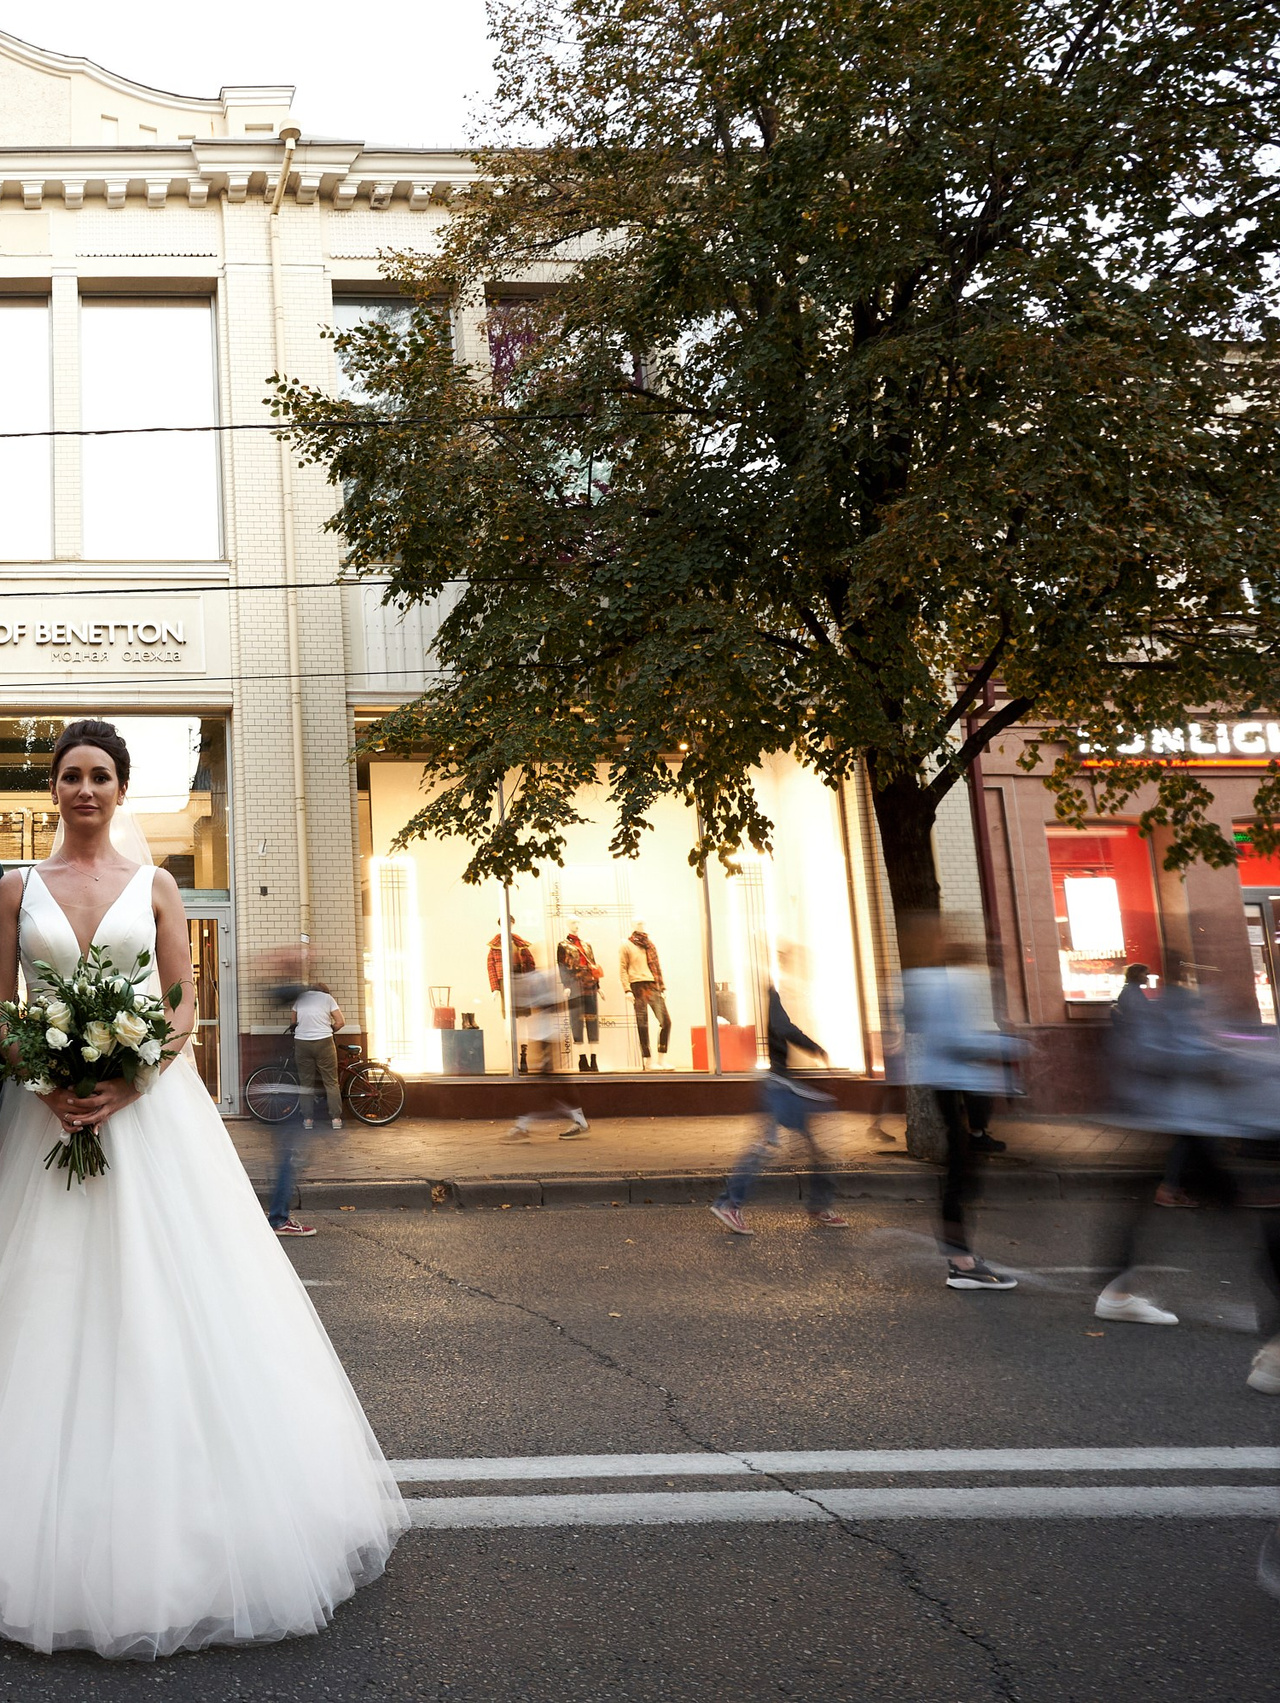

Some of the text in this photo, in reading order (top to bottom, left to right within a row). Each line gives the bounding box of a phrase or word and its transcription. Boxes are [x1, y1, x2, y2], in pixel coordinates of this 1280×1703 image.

[35, 620, 187, 645] BENETTON.
[51, 650, 181, 662] модная одежда
